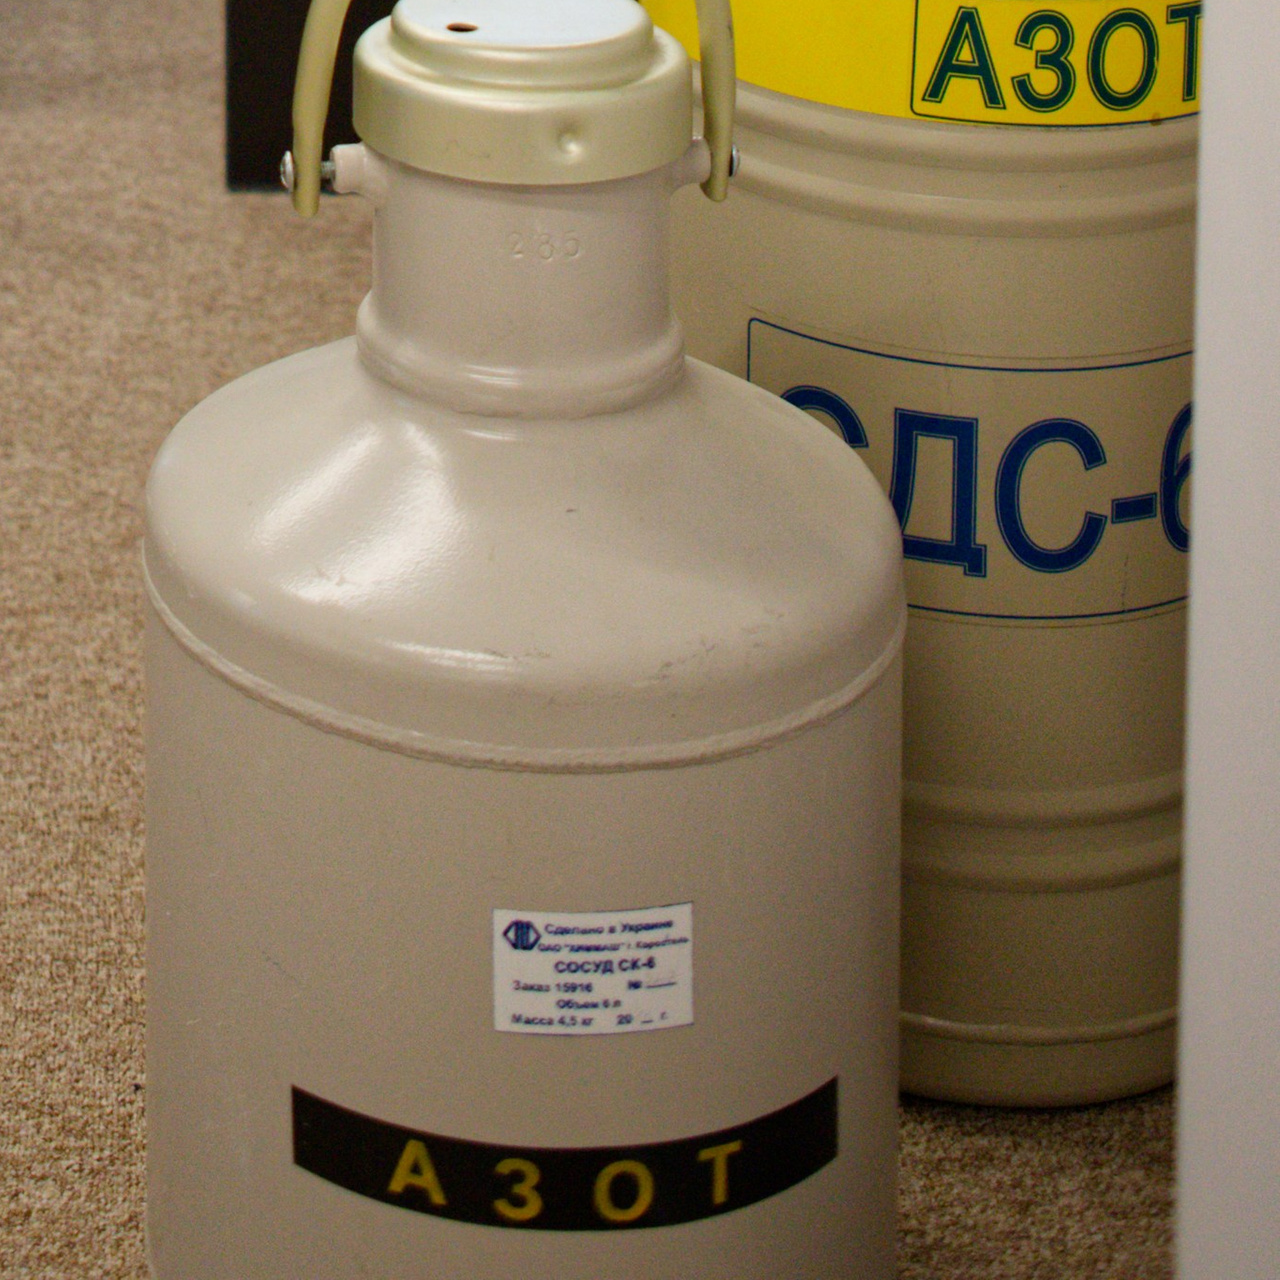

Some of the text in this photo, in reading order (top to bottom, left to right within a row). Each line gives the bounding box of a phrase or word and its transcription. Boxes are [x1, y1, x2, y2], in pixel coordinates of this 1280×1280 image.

[922, 5, 1202, 113] АЗОТ
[544, 923, 604, 936] Сделано
[554, 960, 614, 974] СОСУД
[513, 980, 550, 992] Заказ
[511, 1014, 554, 1025] Масса
[387, 1140, 741, 1221] АЗОТ
